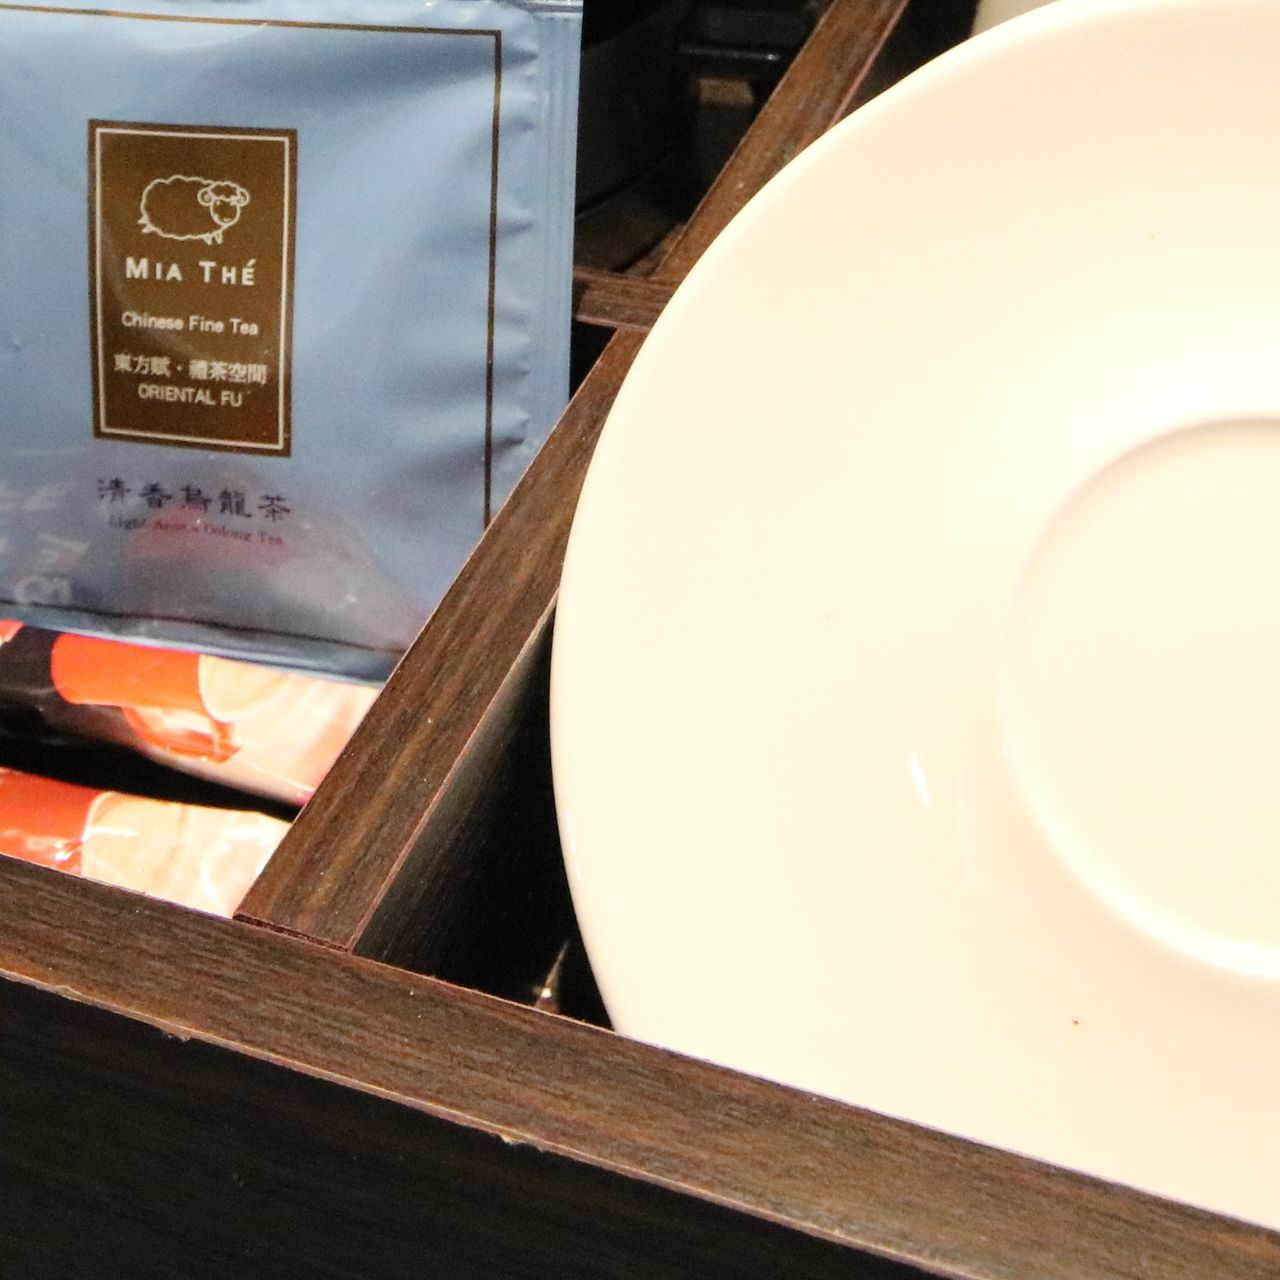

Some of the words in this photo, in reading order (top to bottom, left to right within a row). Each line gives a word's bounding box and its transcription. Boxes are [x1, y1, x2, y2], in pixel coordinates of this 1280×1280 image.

[125, 256, 182, 281] MIA
[199, 258, 257, 286] THÉ
[121, 310, 184, 331] Chinese
[188, 314, 225, 333] Fine
[229, 317, 260, 336] Tea
[137, 382, 217, 406] ORIENTAL
[220, 390, 243, 407] FU
